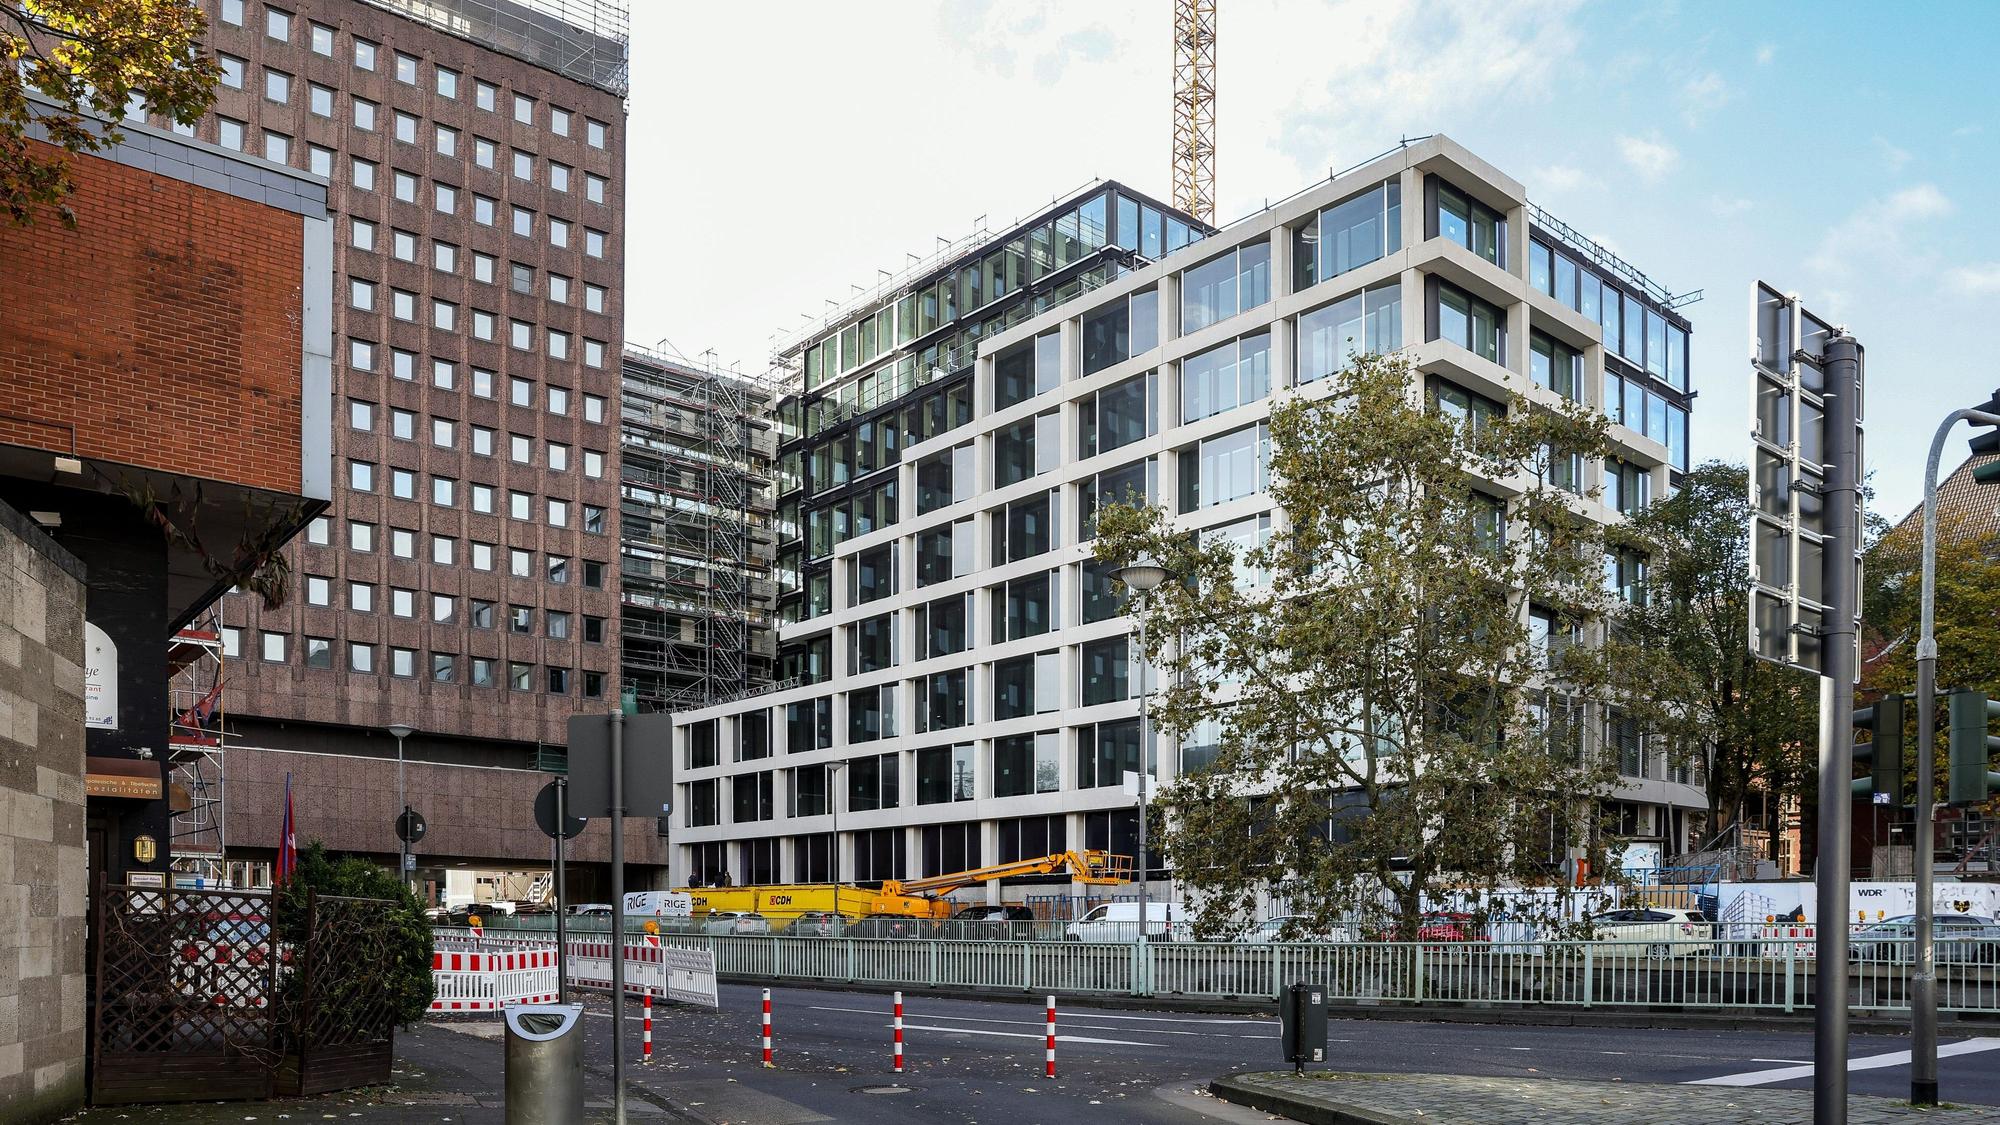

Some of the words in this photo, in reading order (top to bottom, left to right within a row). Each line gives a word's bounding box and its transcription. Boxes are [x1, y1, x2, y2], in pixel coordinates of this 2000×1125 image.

[1858, 889, 1882, 897] WDR
[627, 893, 648, 911] RIGE
[664, 899, 687, 909] RIGE
[691, 897, 708, 907] CDH
